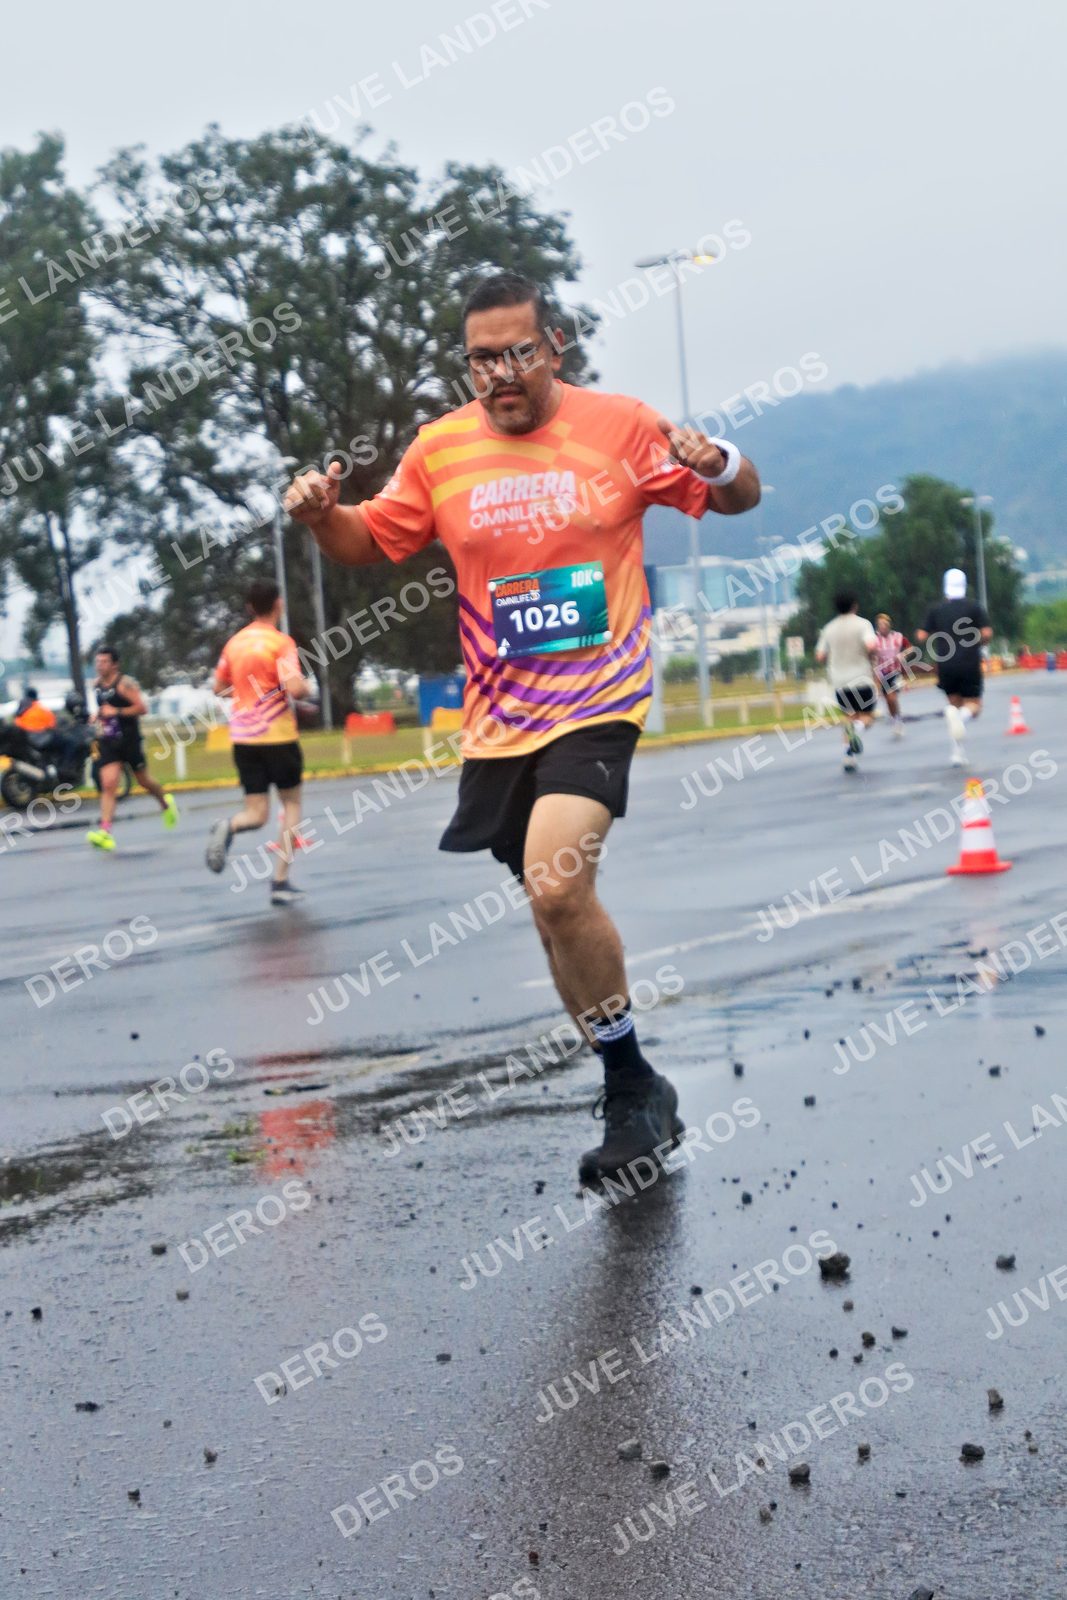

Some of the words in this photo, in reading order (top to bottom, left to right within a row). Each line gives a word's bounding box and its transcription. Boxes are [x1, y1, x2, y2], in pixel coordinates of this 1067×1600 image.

[470, 470, 577, 511] CARRERA
[470, 500, 551, 529] OMNILIFE
[495, 578, 540, 598] CARRERA
[570, 569, 593, 588] 10K
[496, 593, 530, 607] OMNILIFE
[509, 600, 580, 633] 1026
